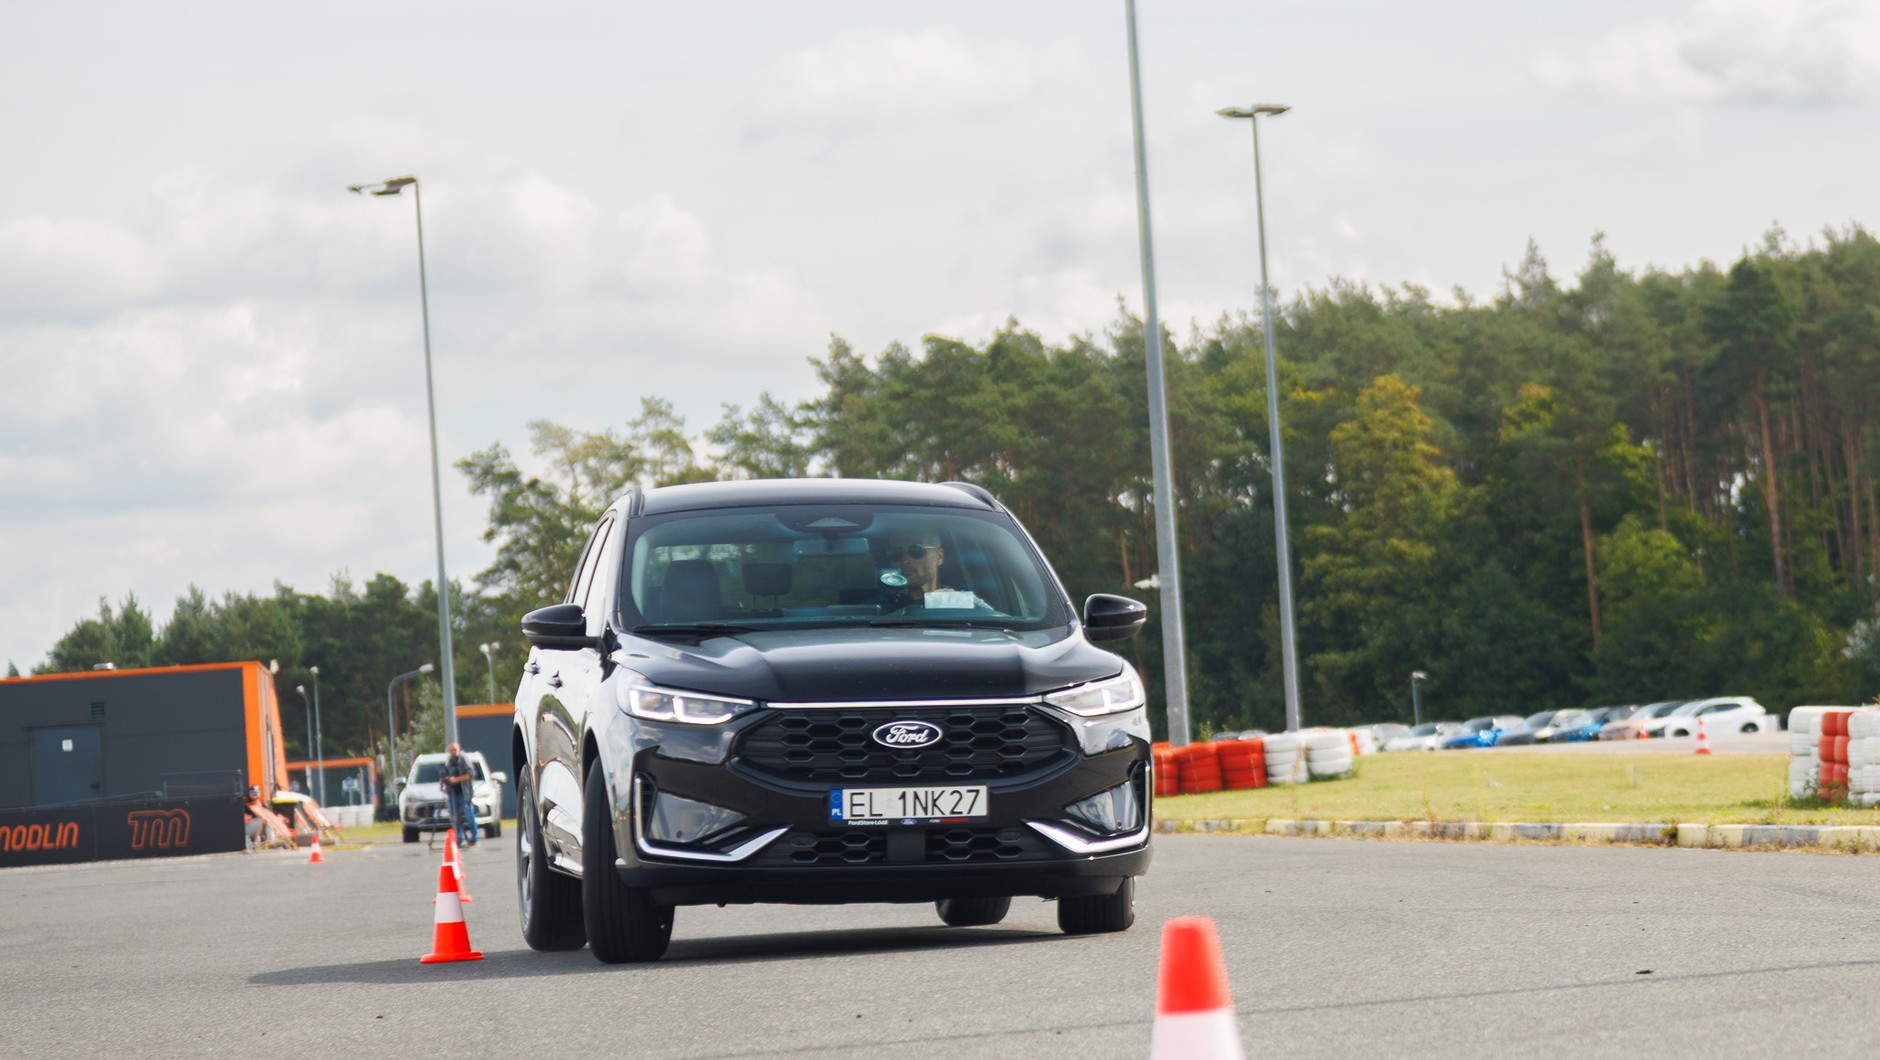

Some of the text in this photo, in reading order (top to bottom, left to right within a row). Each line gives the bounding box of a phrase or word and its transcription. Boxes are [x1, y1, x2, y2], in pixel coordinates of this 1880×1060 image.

[886, 725, 928, 743] Ford
[831, 808, 842, 816] PL
[850, 789, 980, 817] EL 1NK27
